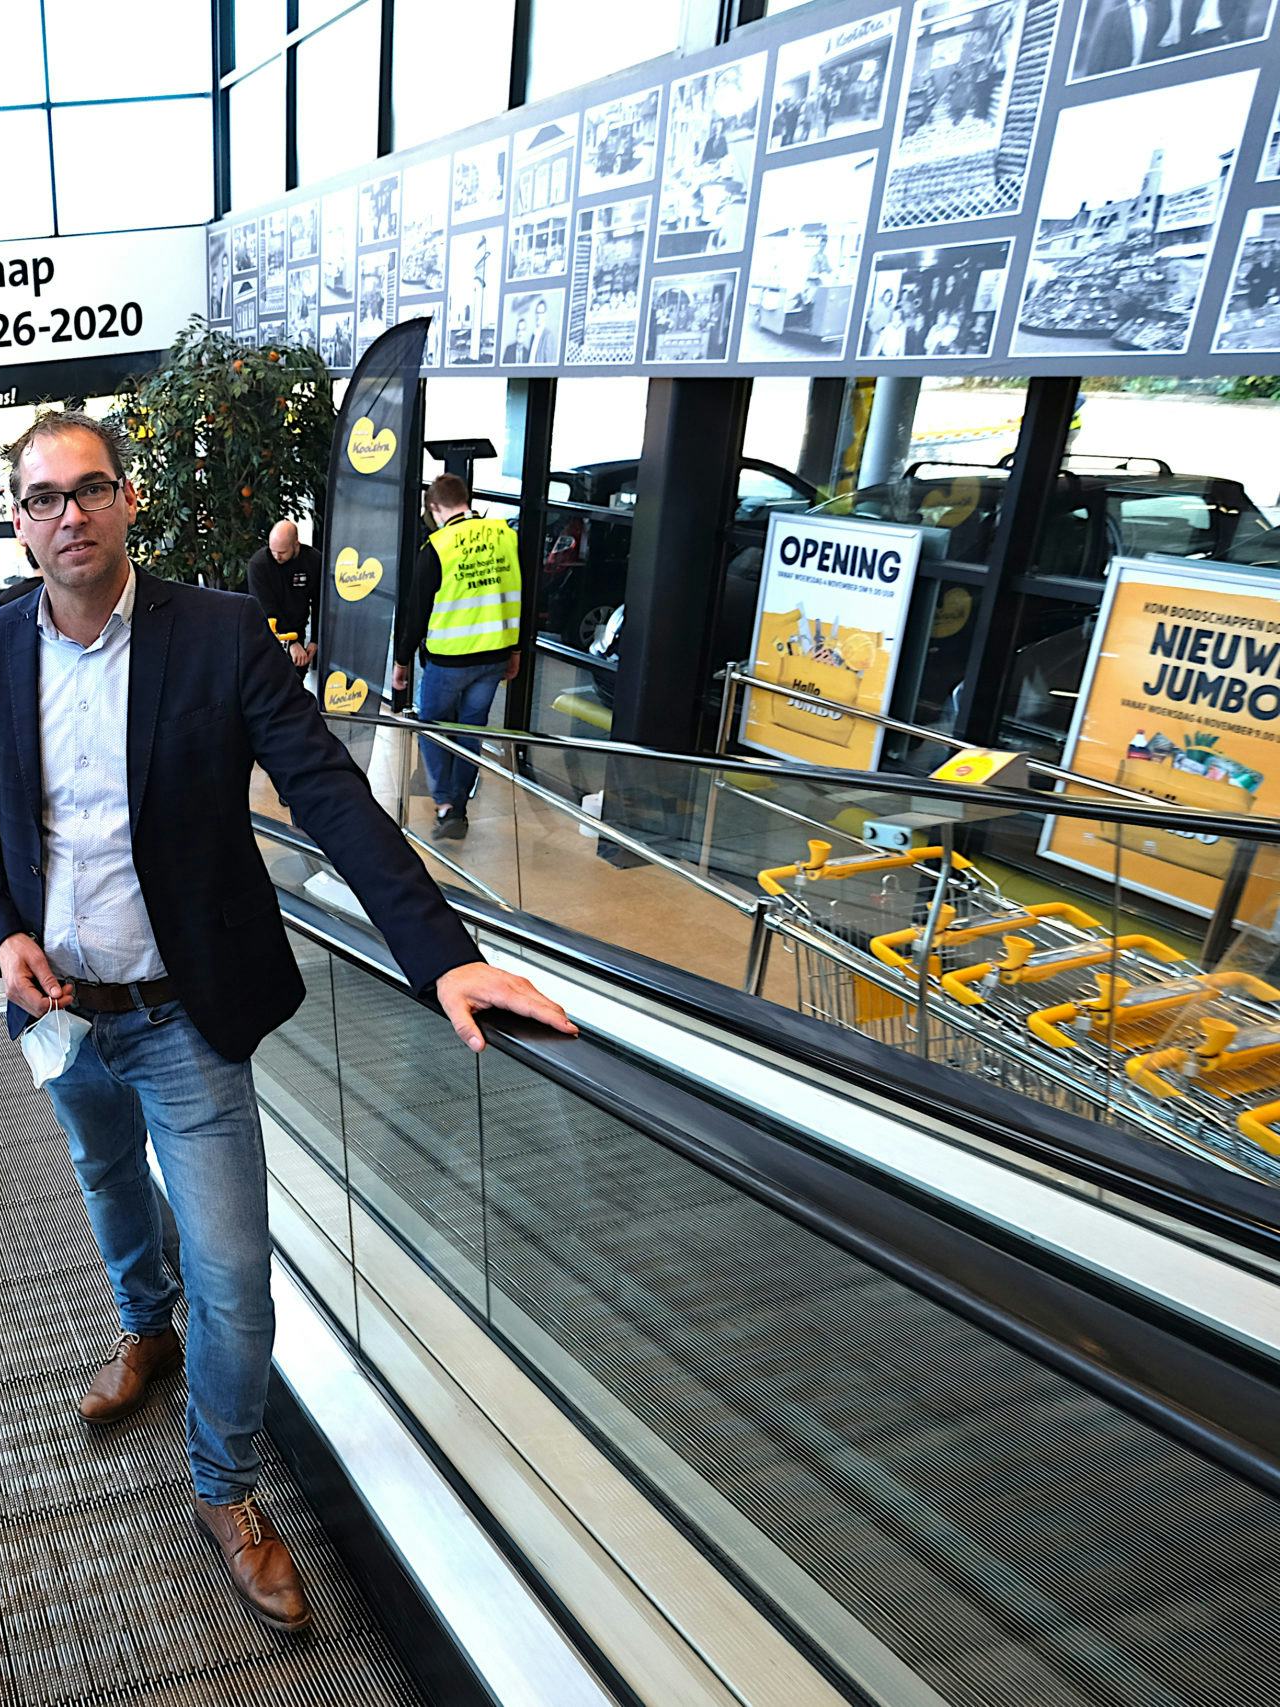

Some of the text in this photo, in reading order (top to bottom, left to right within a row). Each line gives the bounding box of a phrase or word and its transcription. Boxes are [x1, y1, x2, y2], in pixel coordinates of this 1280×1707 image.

[462, 542, 495, 562] graag
[780, 535, 901, 583] OPENING
[339, 570, 376, 584] Kooistra
[1143, 602, 1169, 616] KOM
[1170, 606, 1266, 632] BOODSCHAPPEN
[1149, 621, 1280, 680] NIEUW
[792, 679, 821, 696] Hallo
[1142, 663, 1280, 721] JUMBO
